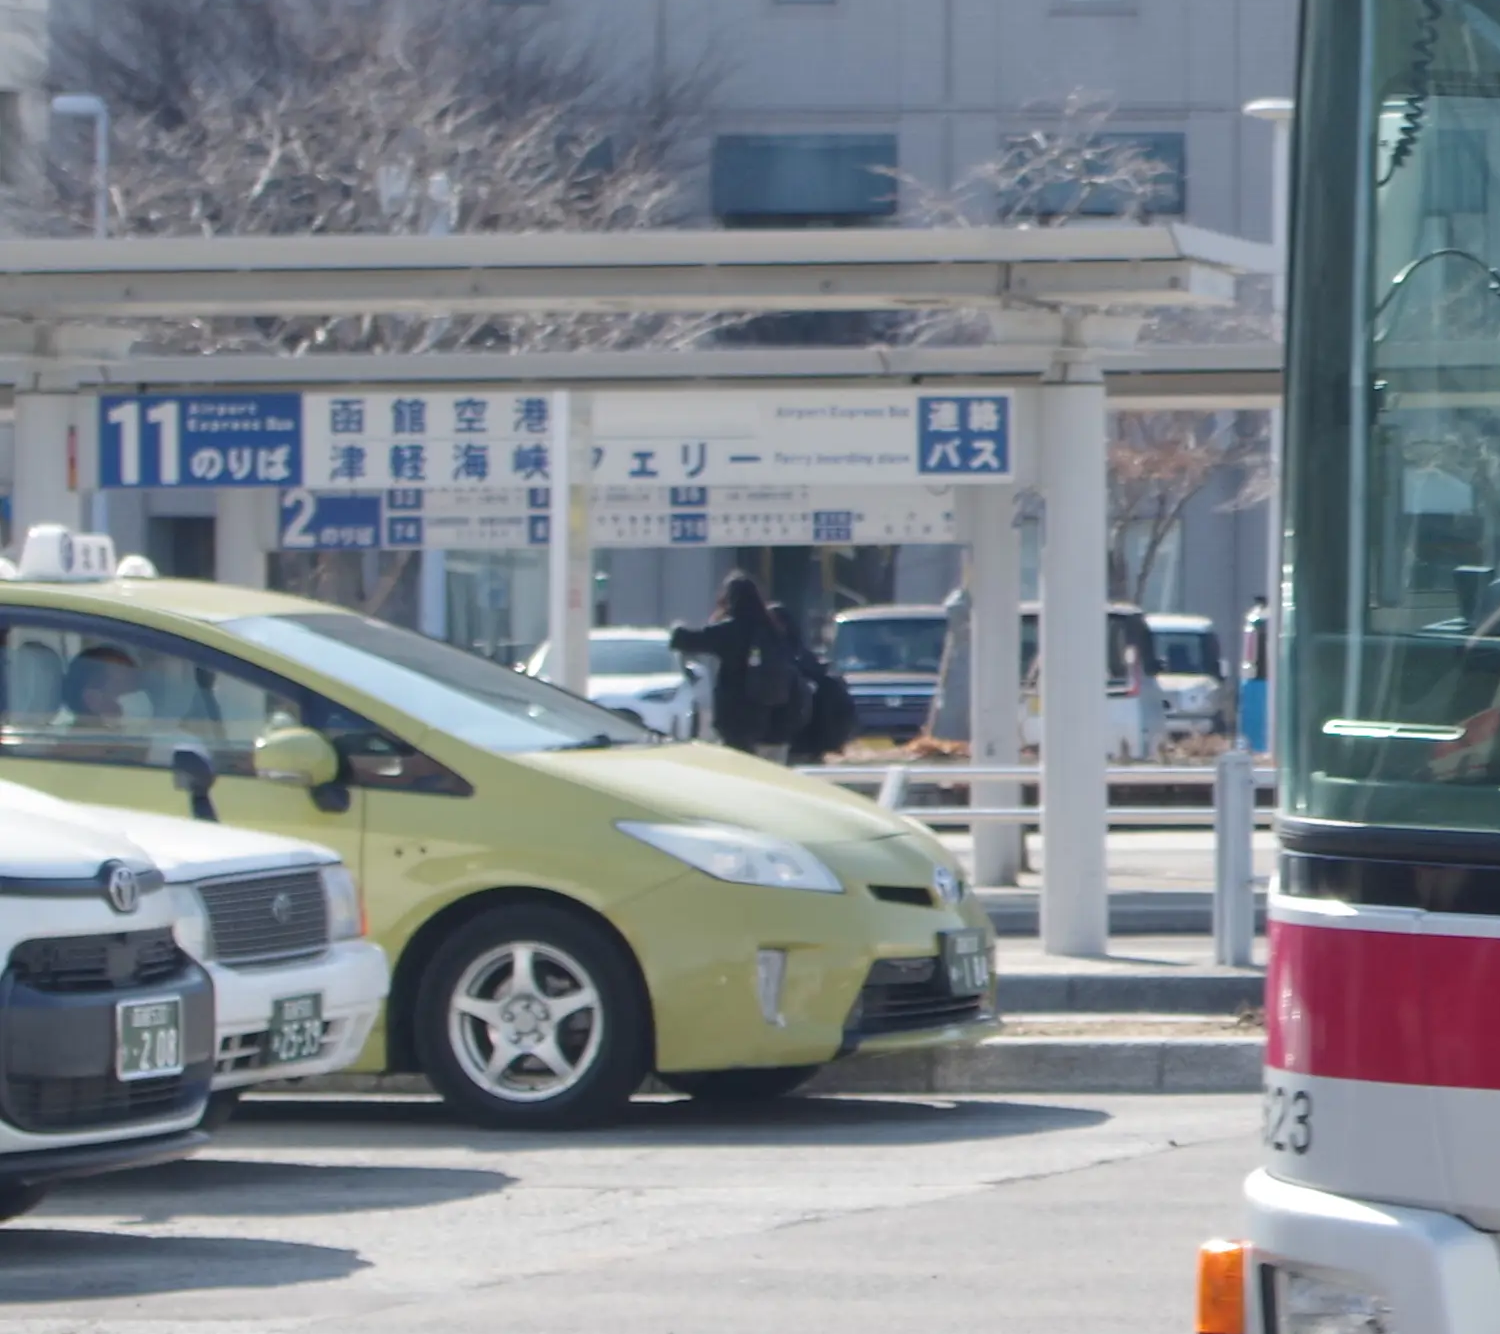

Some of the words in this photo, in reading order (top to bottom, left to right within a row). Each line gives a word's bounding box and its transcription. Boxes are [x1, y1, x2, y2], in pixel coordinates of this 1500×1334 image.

[329, 398, 549, 435] 函館空港
[927, 400, 999, 433] 連絡
[108, 400, 180, 485] 11
[927, 440, 999, 470] バス
[189, 445, 292, 481] のりば
[282, 488, 317, 548] 2
